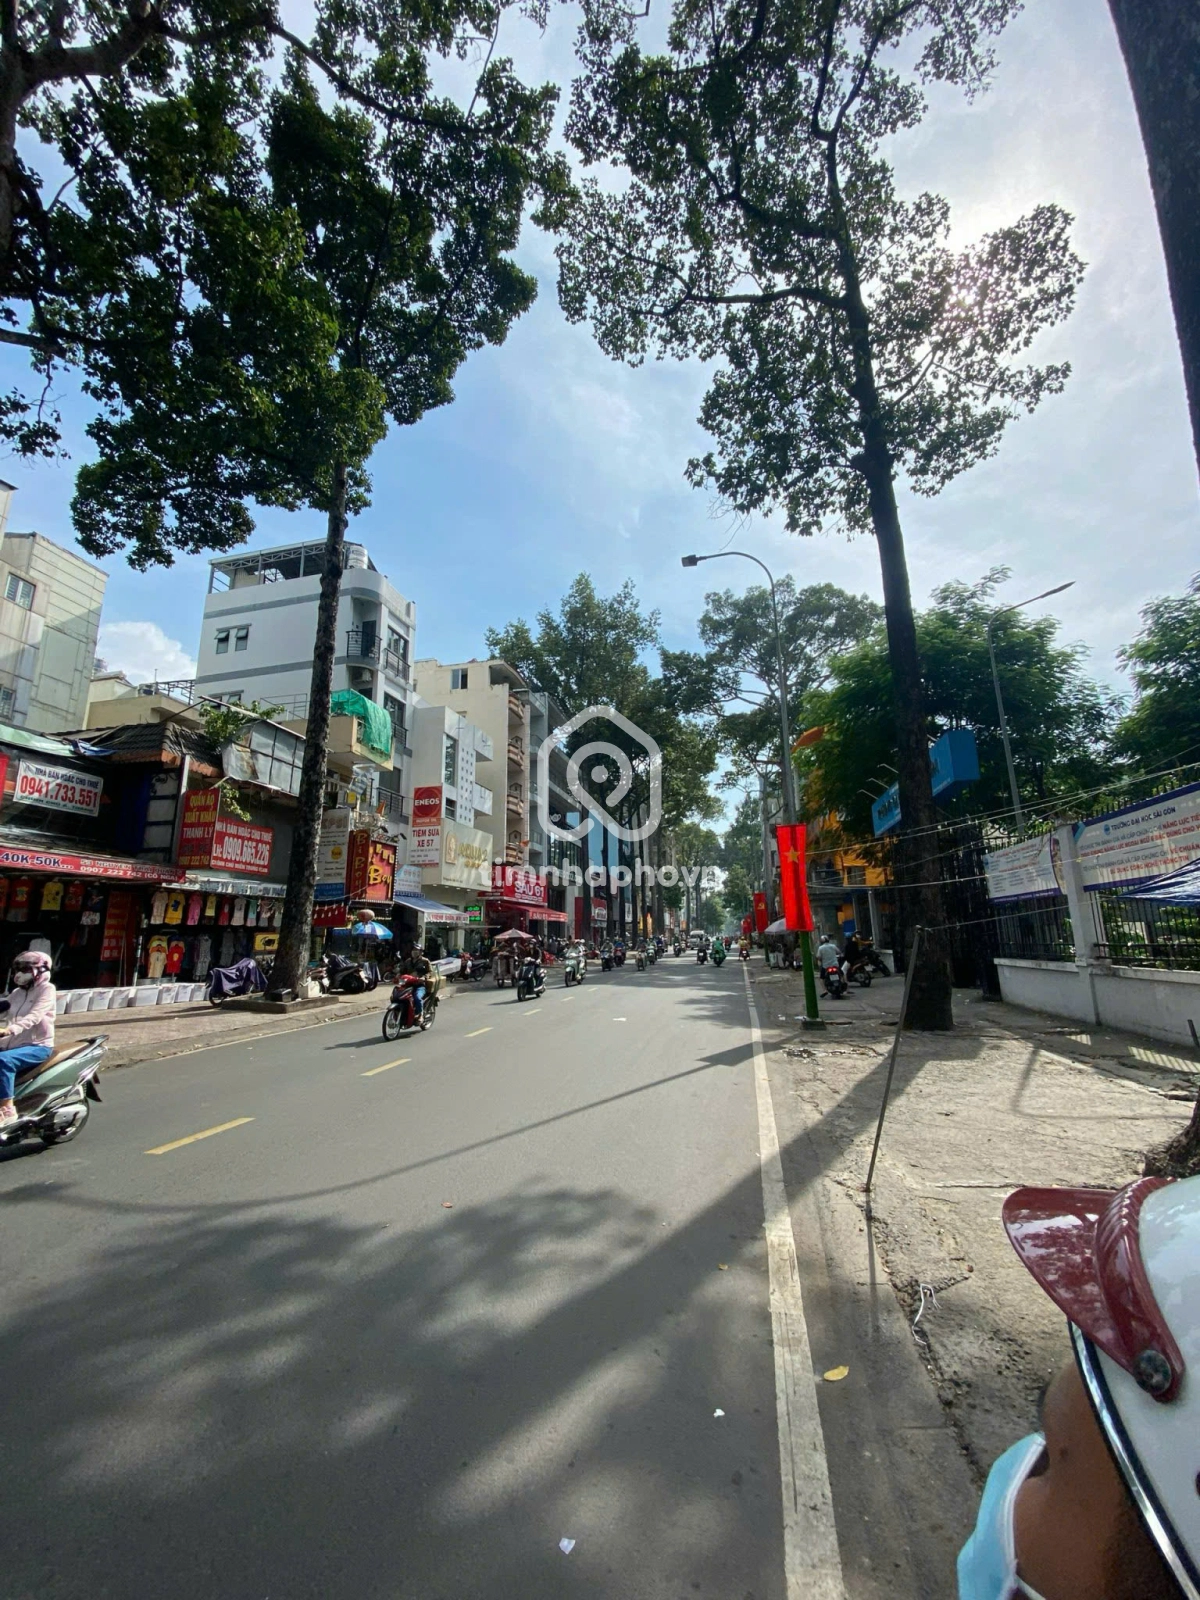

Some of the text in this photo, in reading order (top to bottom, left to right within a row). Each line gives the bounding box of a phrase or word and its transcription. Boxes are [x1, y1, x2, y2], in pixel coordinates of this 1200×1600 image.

[76, 777, 86, 786] CHO
[20, 775, 98, 808] 0941.733.551
[414, 798, 440, 806] ENEOS
[183, 826, 214, 838] THANH LÝ
[222, 836, 270, 866] 0909.665.226
[106, 868, 124, 876] 222
[534, 886, 544, 898] 61
